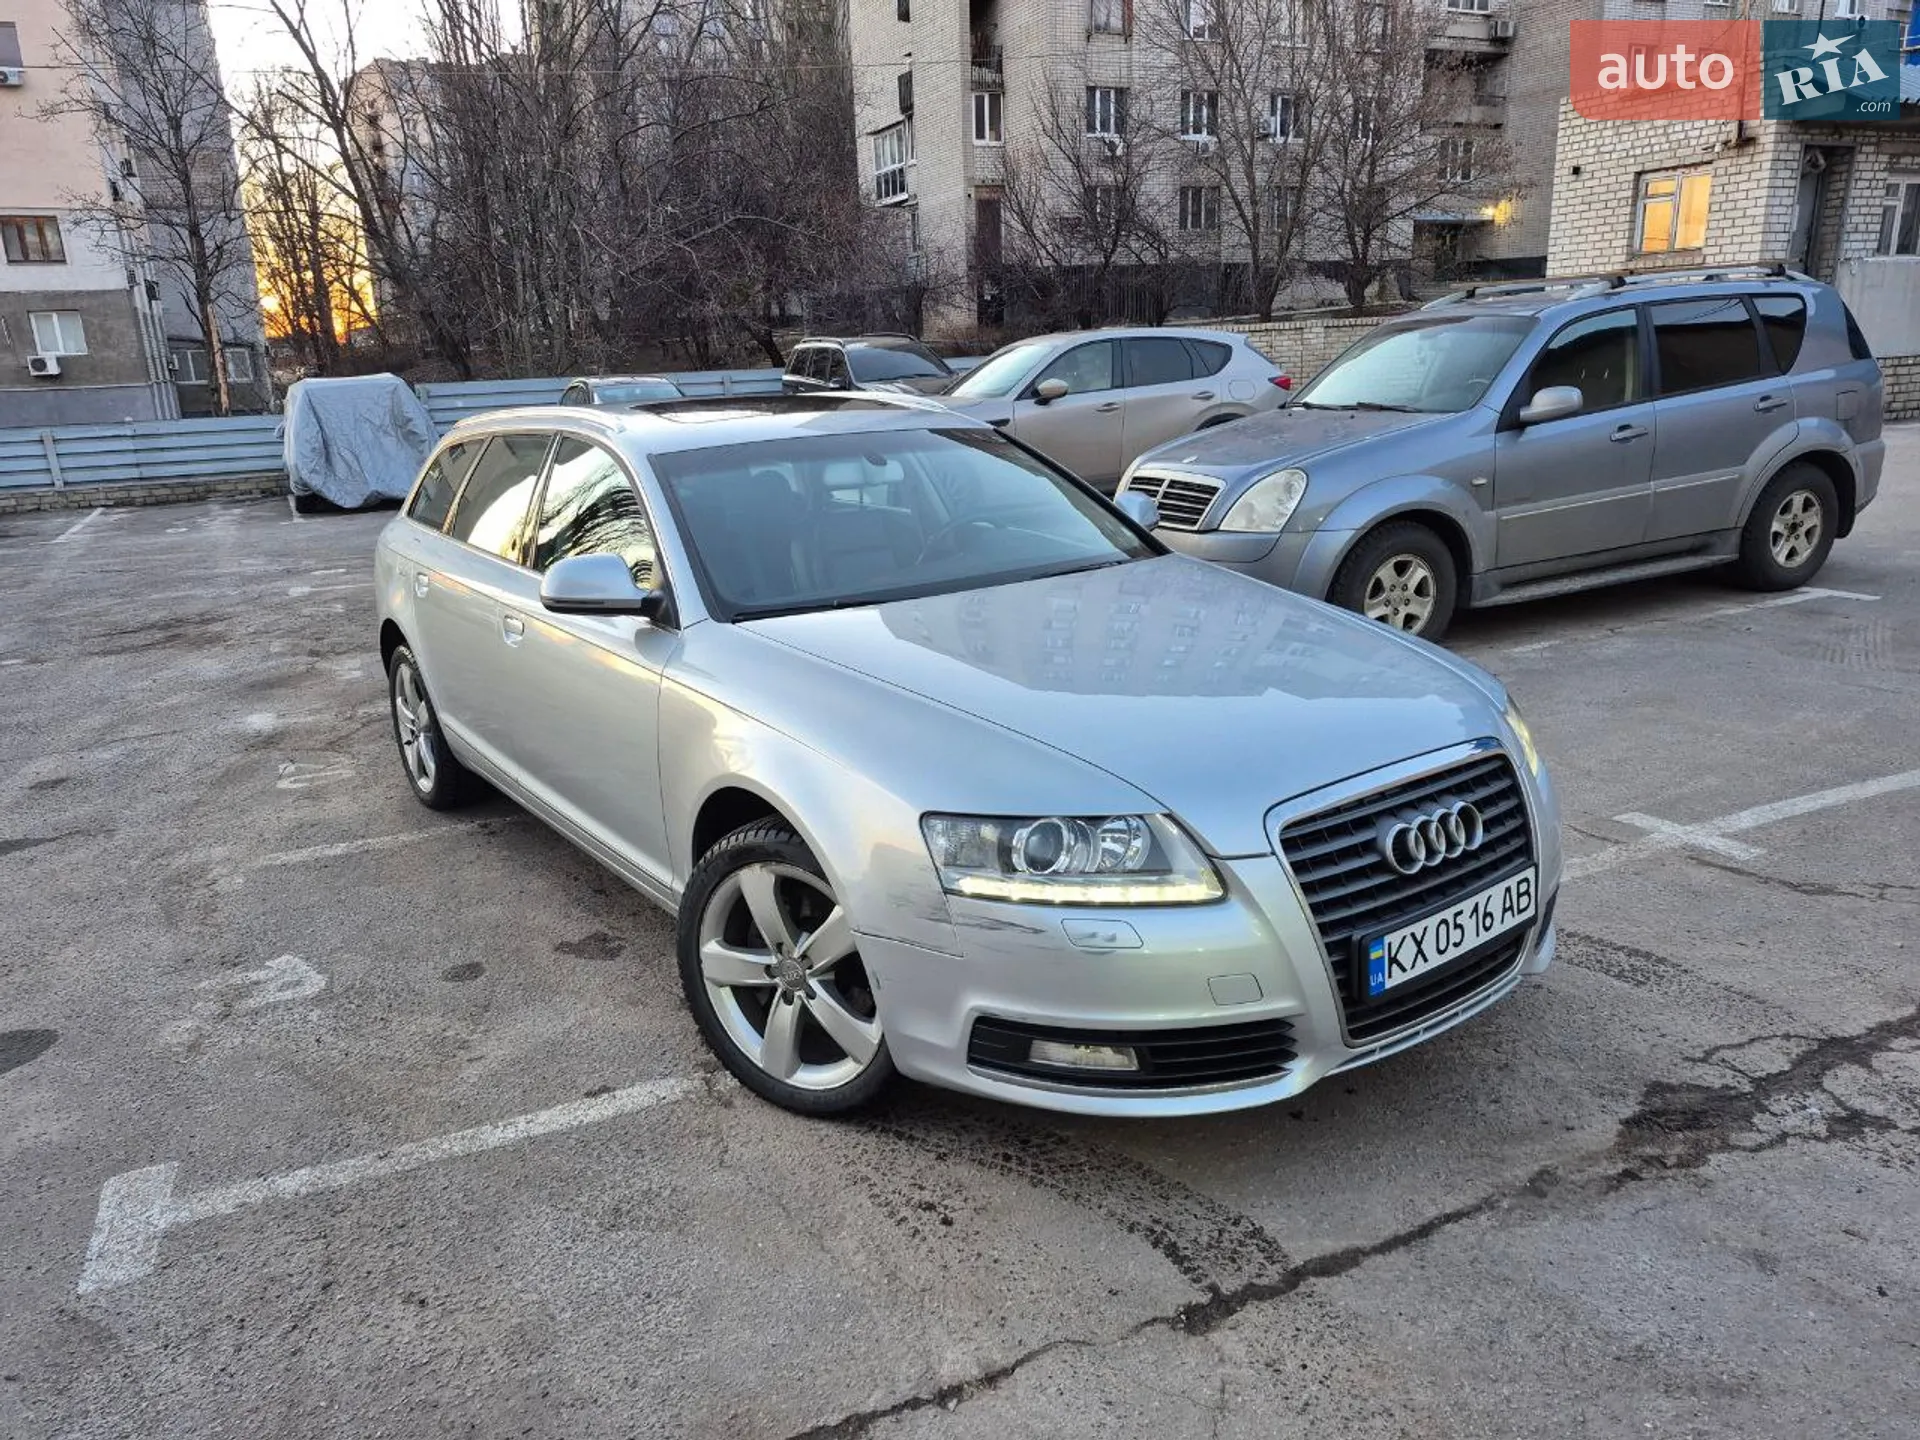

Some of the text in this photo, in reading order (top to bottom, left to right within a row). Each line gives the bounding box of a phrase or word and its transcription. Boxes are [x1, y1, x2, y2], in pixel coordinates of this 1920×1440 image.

[1387, 877, 1532, 979] KX 0516 AB
[1369, 972, 1384, 987] UA
